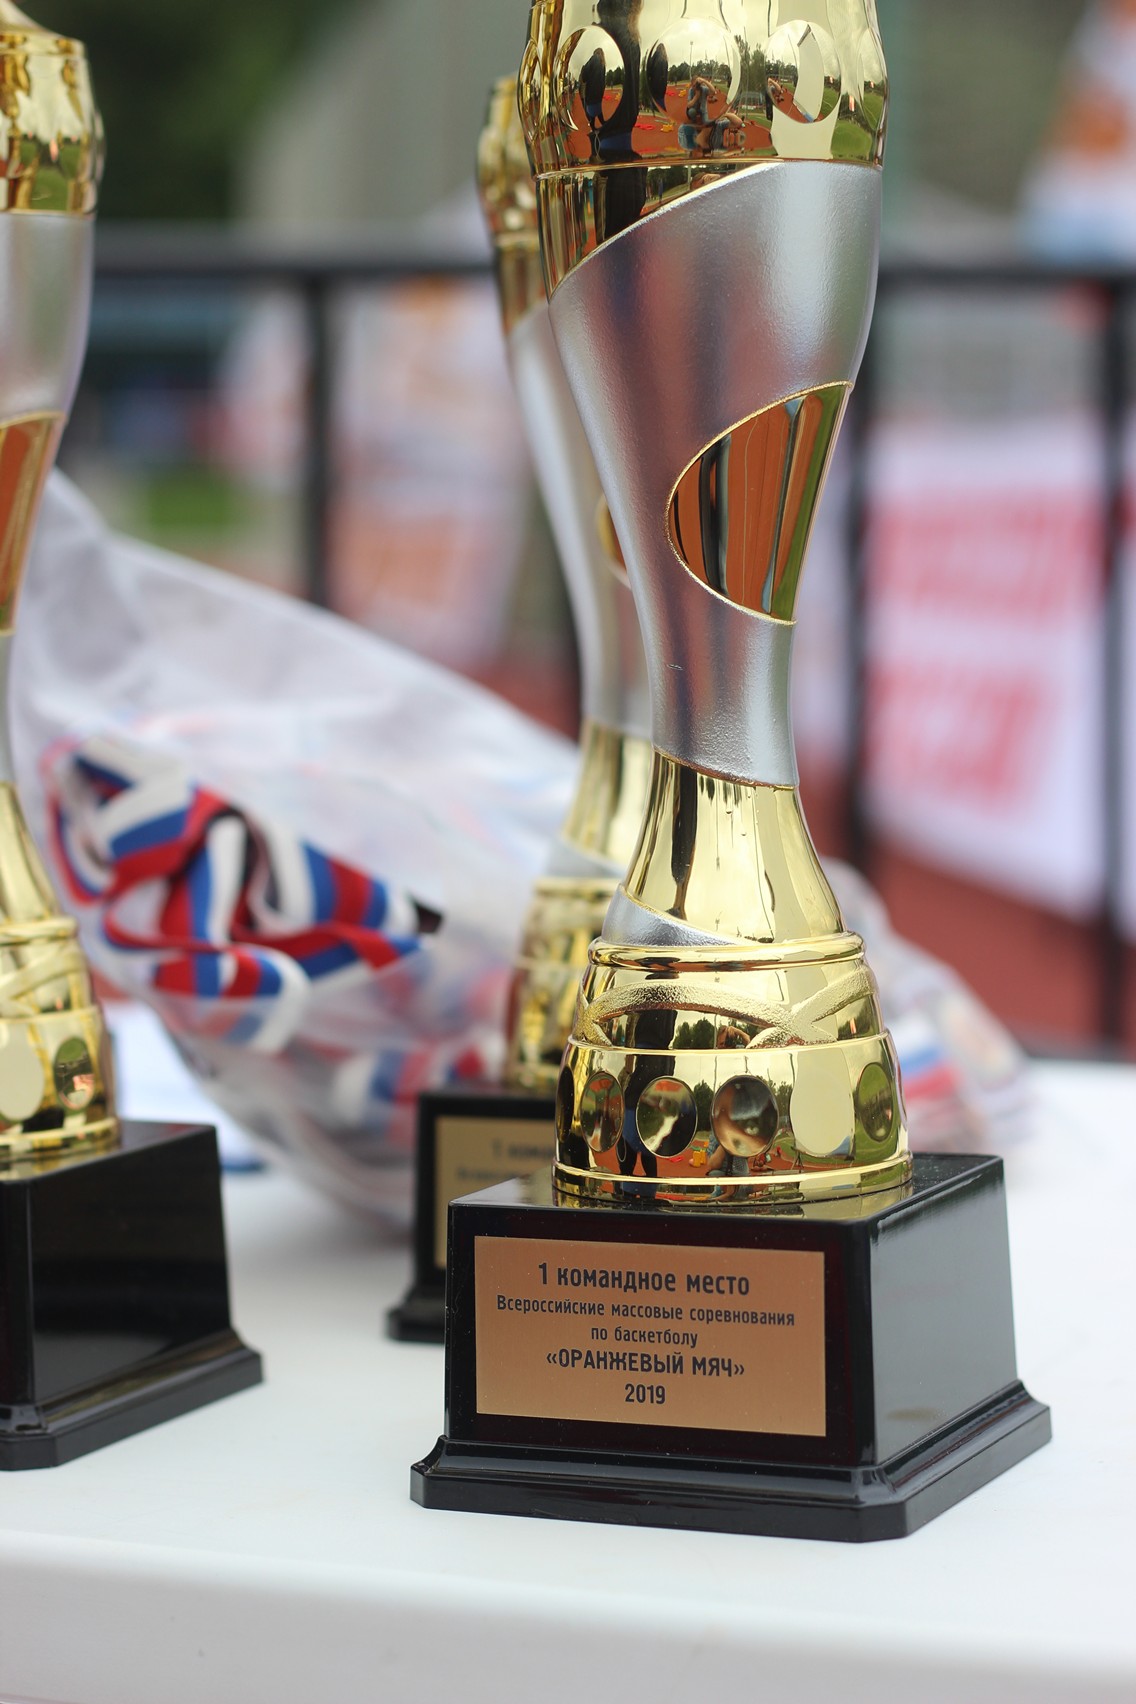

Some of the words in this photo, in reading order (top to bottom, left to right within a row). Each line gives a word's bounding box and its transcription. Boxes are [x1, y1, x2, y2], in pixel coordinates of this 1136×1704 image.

[538, 1262, 549, 1285] 1
[557, 1267, 676, 1292] командное
[686, 1275, 750, 1295] место
[497, 1295, 605, 1316] Всероссийские
[611, 1304, 683, 1320] массовые
[689, 1308, 795, 1327] соревнования
[591, 1327, 608, 1341] по
[614, 1326, 698, 1347] баскетболу
[546, 1349, 684, 1375] «ОРАНЖЕВЫЙ
[692, 1357, 745, 1377] МЯЧ»
[624, 1383, 666, 1405] 2019
